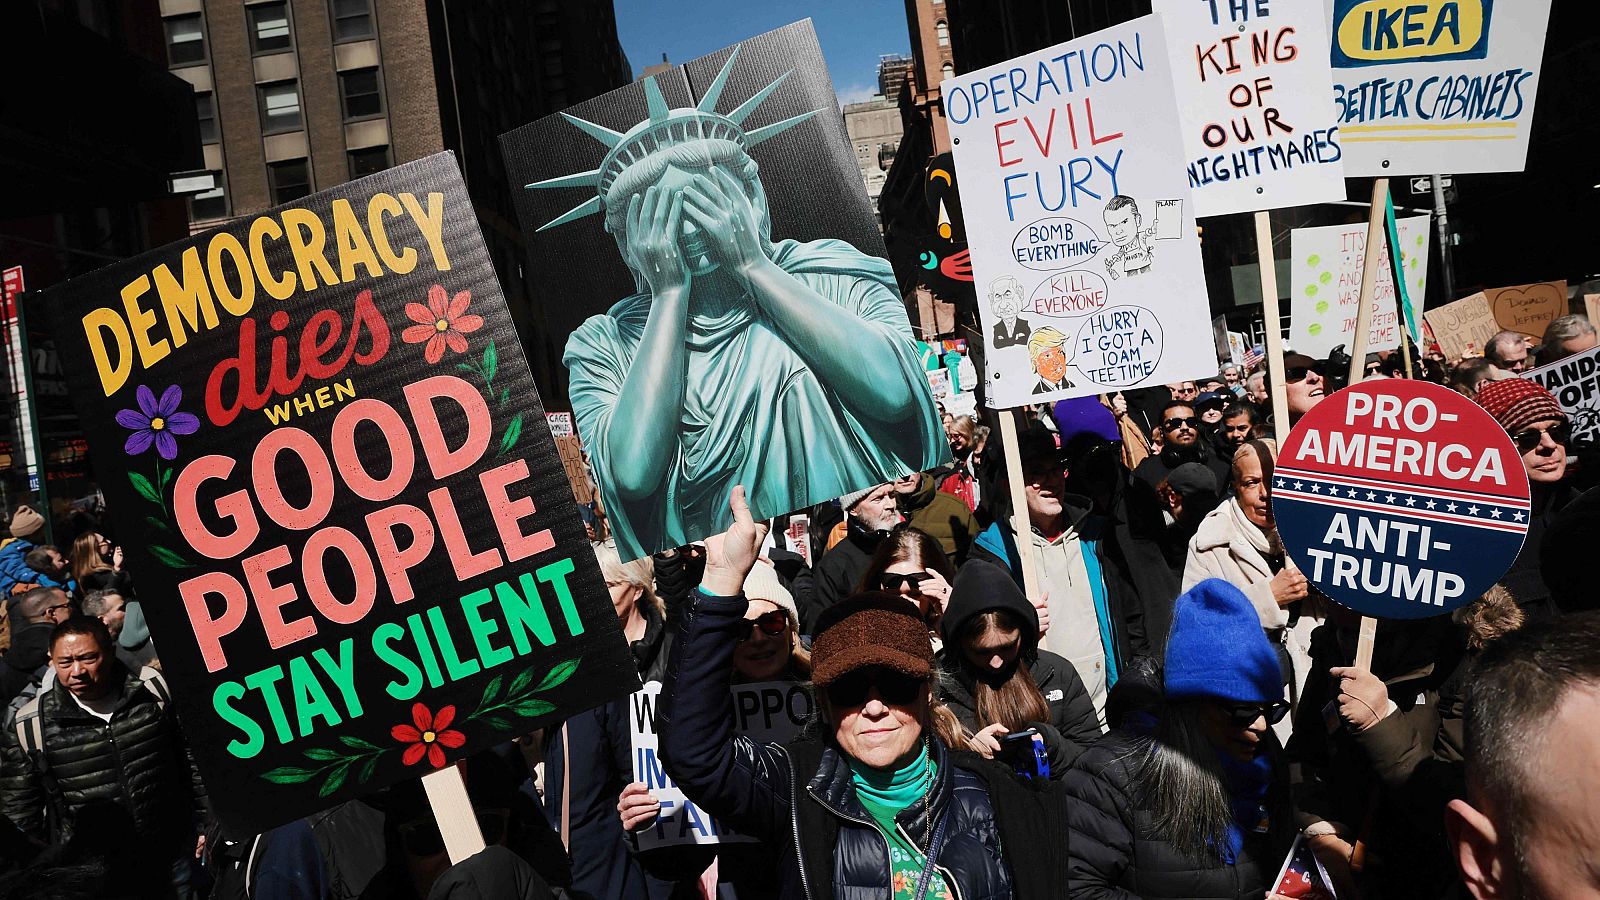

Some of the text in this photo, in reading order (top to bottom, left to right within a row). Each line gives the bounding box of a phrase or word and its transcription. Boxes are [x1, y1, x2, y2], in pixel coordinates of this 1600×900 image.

[1202, 0, 1269, 25] THE
[1361, 3, 1460, 51] IKEA
[948, 32, 1144, 125] OPERATION
[1195, 26, 1297, 83] KING
[1228, 76, 1274, 108] OF
[1333, 68, 1533, 123] BETTER CABINETS
[995, 97, 1123, 167] EVIL
[1201, 107, 1294, 149] OUR
[1187, 126, 1341, 189] NIGHTMARES
[1004, 149, 1123, 221] FURY
[1017, 239, 1099, 263] EVERYTHING
[1029, 223, 1073, 244] BOMB
[82, 191, 450, 397] DEMOCRACY
[1035, 291, 1104, 315] EVERYONE
[1050, 275, 1092, 294] KILL
[1082, 329, 1154, 354] I GOT A
[1090, 309, 1140, 335] HURRY
[205, 289, 391, 427] dies
[1087, 361, 1152, 382] TEE TIME
[1103, 348, 1141, 366] 10AM
[263, 378, 356, 426] WHEN
[1345, 391, 1459, 433] PRO-
[173, 375, 492, 560] GOOD
[1295, 428, 1507, 486] AMERICA
[1322, 512, 1452, 561] ANTI-
[178, 458, 556, 673] PEOPLE
[1307, 548, 1466, 607] TRUMP
[212, 557, 586, 760] STAY SILENT
